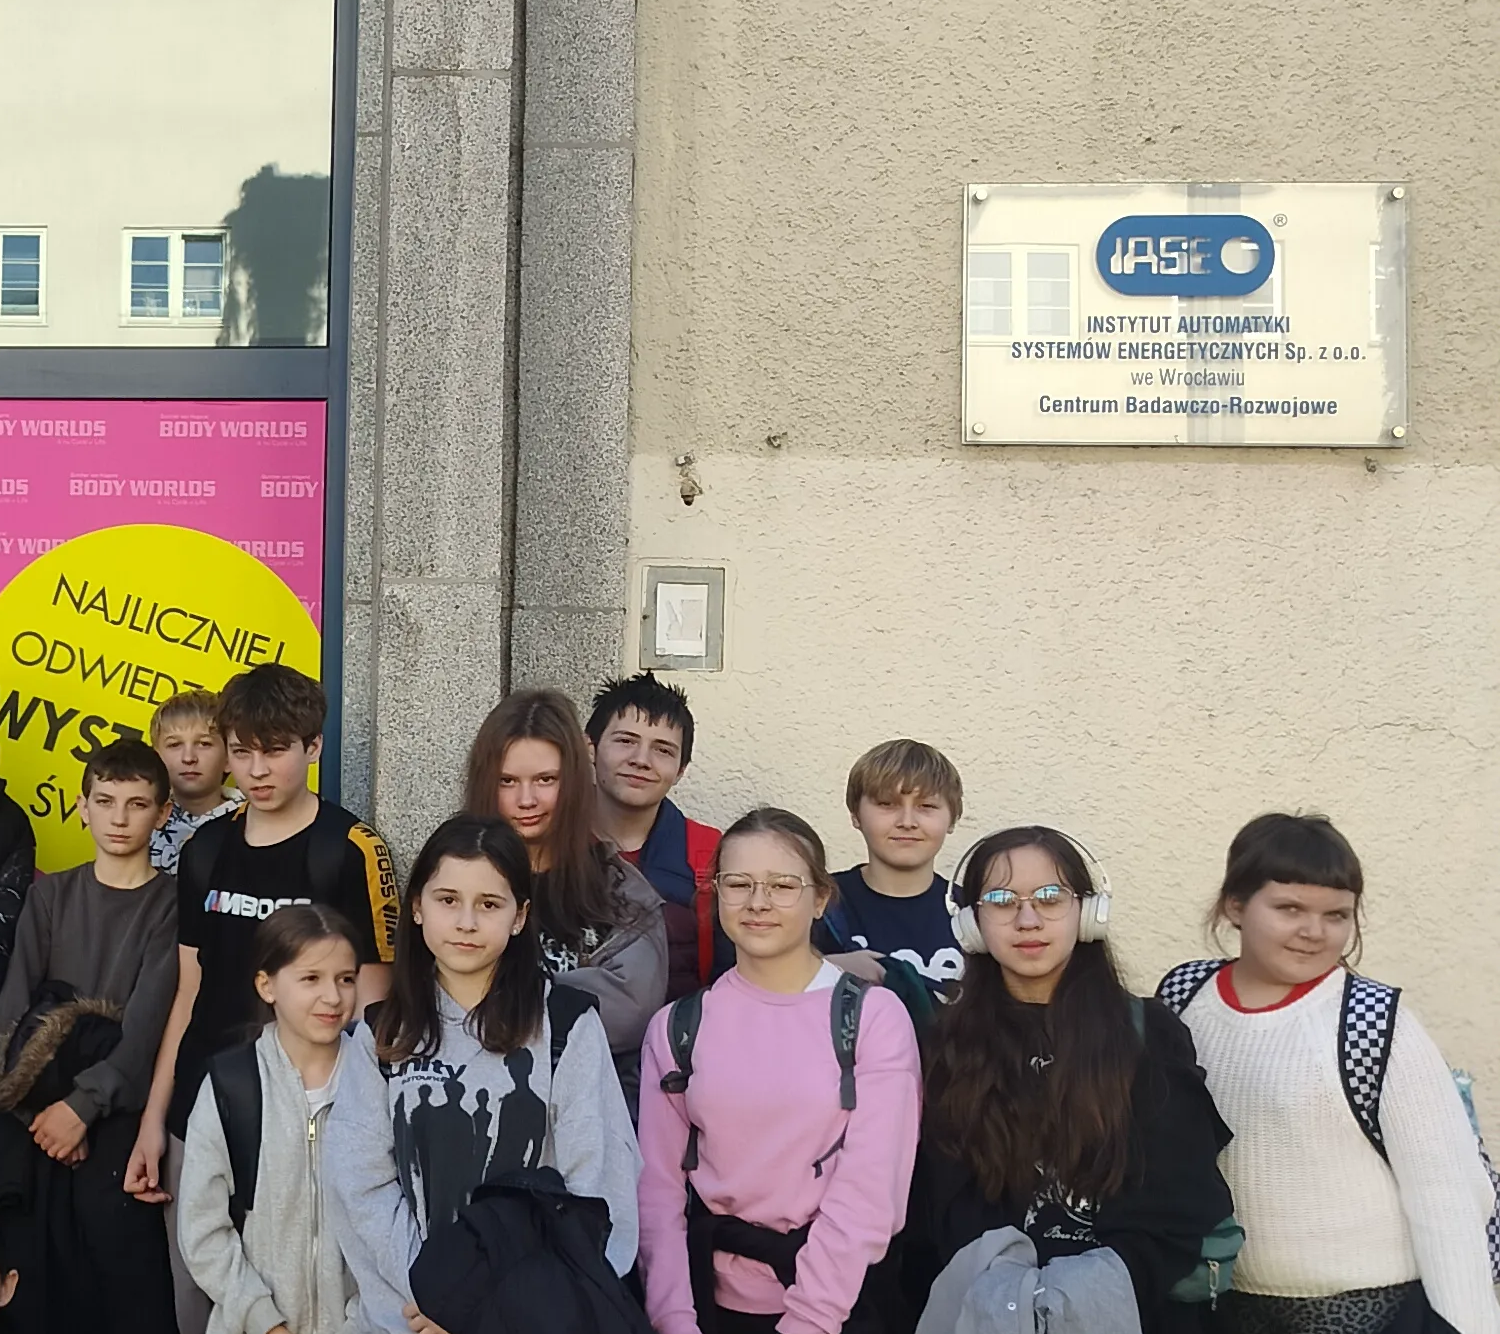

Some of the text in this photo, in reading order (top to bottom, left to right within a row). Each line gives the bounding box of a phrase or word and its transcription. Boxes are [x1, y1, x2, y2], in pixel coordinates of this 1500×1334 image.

[1086, 315, 1291, 333] INSTYTUT AUTOMATYKI
[1011, 337, 1368, 364] SYSTEMÓW ENERGETYCZNYCH Sp. z o.o.
[1130, 367, 1246, 387] we Wrocławiu
[1038, 395, 1338, 419] Centrum Badawczo-Rozwojowe
[21, 420, 106, 436] WORLDS
[159, 421, 307, 438] BODY WORLDS
[69, 480, 216, 497] BODY WORLDS
[260, 481, 319, 498] BODY
